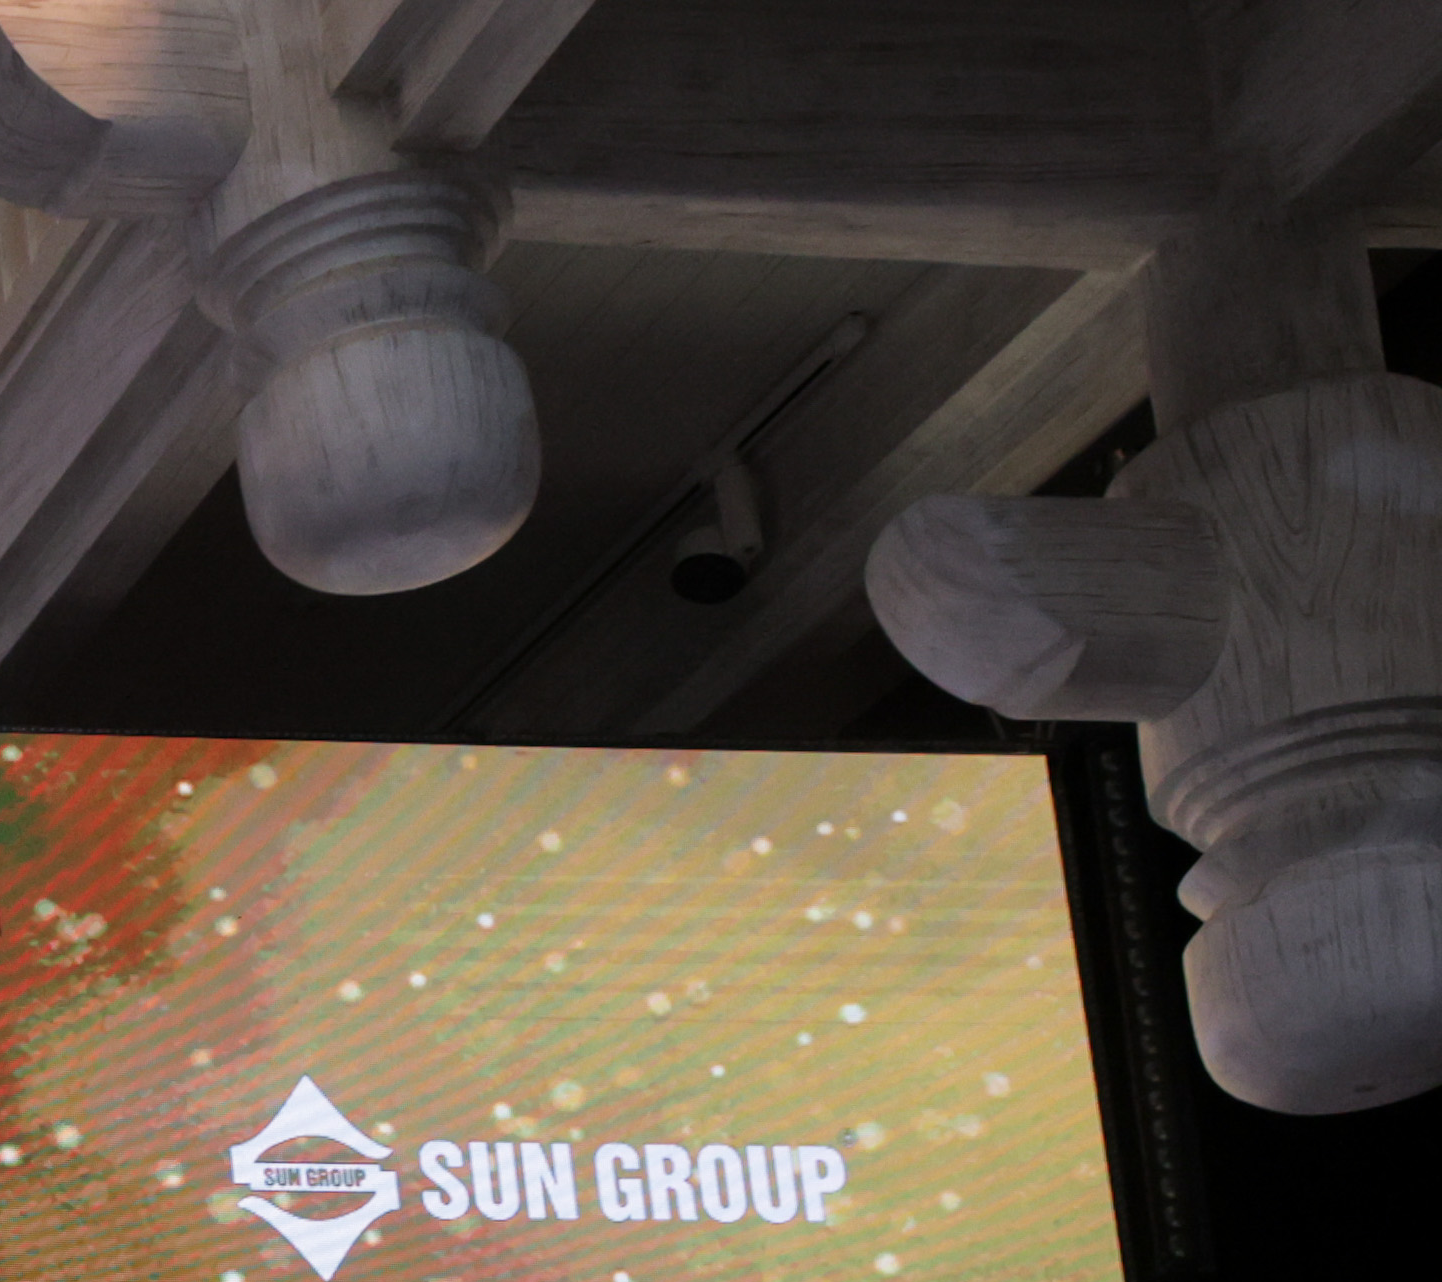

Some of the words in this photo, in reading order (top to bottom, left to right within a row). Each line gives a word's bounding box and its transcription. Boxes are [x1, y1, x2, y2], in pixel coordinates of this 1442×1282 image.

[263, 1167, 300, 1188] SUN
[306, 1168, 367, 1188] GROUP
[418, 1141, 579, 1221] SUN
[594, 1143, 847, 1224] GROUP
